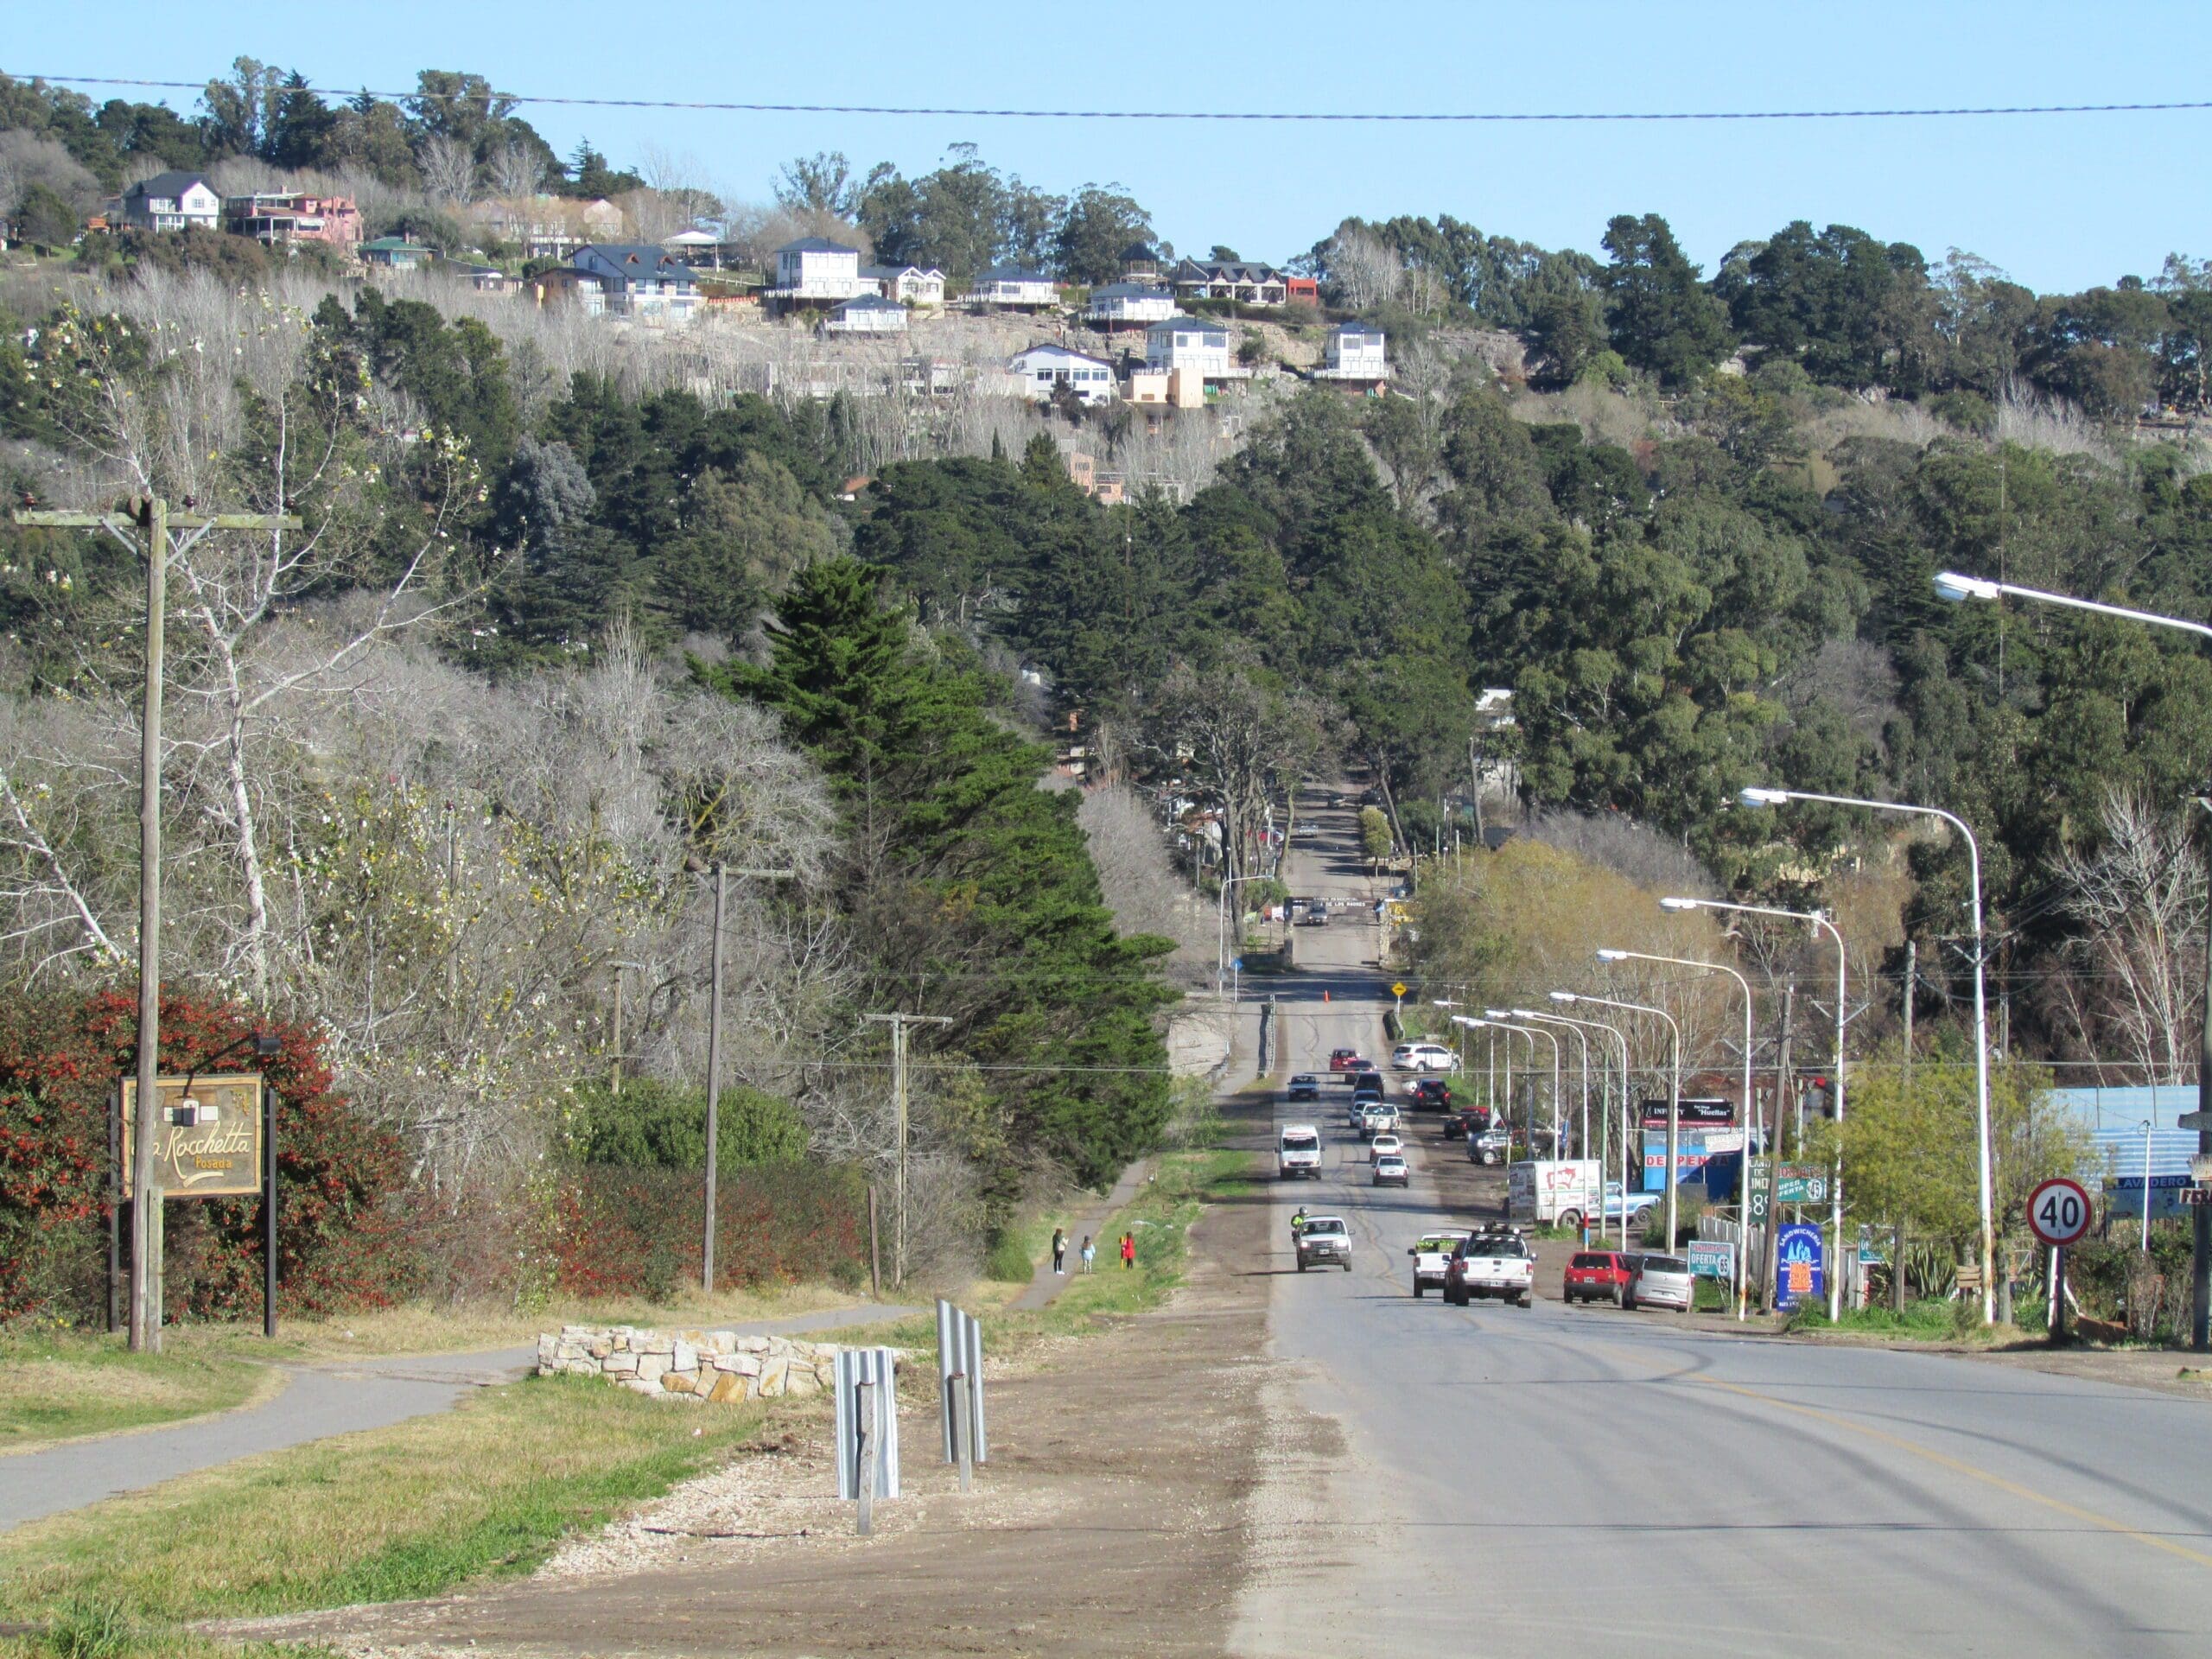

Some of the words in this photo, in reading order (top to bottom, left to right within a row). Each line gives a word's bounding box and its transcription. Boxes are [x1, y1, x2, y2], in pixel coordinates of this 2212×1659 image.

[195, 1157, 232, 1169] Posada
[1646, 1155, 1728, 1166] DEPENSA
[1778, 1179, 1801, 1191] UPER
[1778, 1185, 1804, 1197] FERTA
[2181, 1189, 2212, 1204] FER
[2040, 1196, 2079, 1228] 40
[1779, 1228, 1821, 1247] SANDWICHERIA
[1691, 1253, 1716, 1264] OFERTA
[1720, 1258, 1728, 1273] 65
